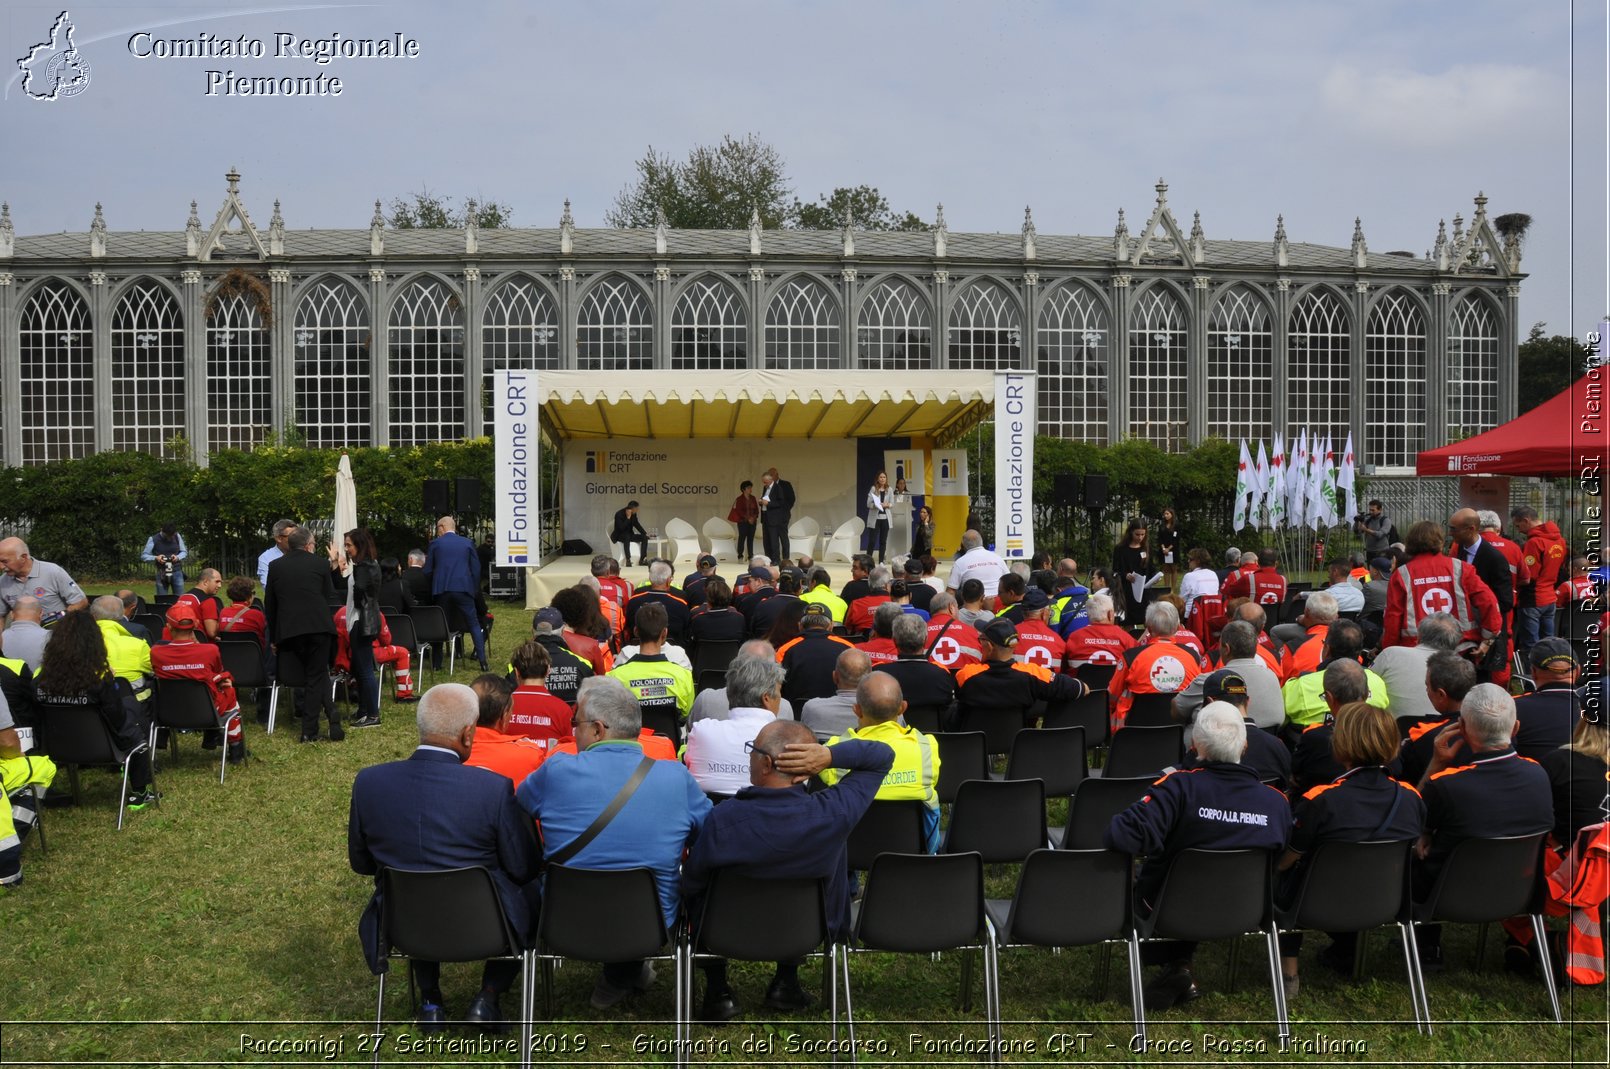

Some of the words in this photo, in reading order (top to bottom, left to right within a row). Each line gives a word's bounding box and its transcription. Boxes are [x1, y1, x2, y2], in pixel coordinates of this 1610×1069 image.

[507, 371, 526, 417] CRT
[1006, 373, 1023, 415] CRT
[609, 451, 667, 461] Fondazione
[1462, 453, 1501, 462] Fondazione
[609, 463, 631, 473] CRT
[1462, 463, 1477, 471] CRT
[507, 422, 528, 543] Fondazione
[1006, 421, 1023, 537] Fondazione
[585, 482, 637, 495] Giornata
[639, 483, 658, 494] del
[661, 482, 719, 495] Soccorso
[560, 666, 577, 674] CIVILE
[550, 674, 577, 682] PIEMONTE
[630, 678, 674, 687] VOLONTARIO
[516, 714, 531, 724] ROSSA
[708, 762, 750, 774] MISERIC
[1198, 806, 1223, 820] CORPO
[1239, 811, 1268, 826] PIEMONTE
